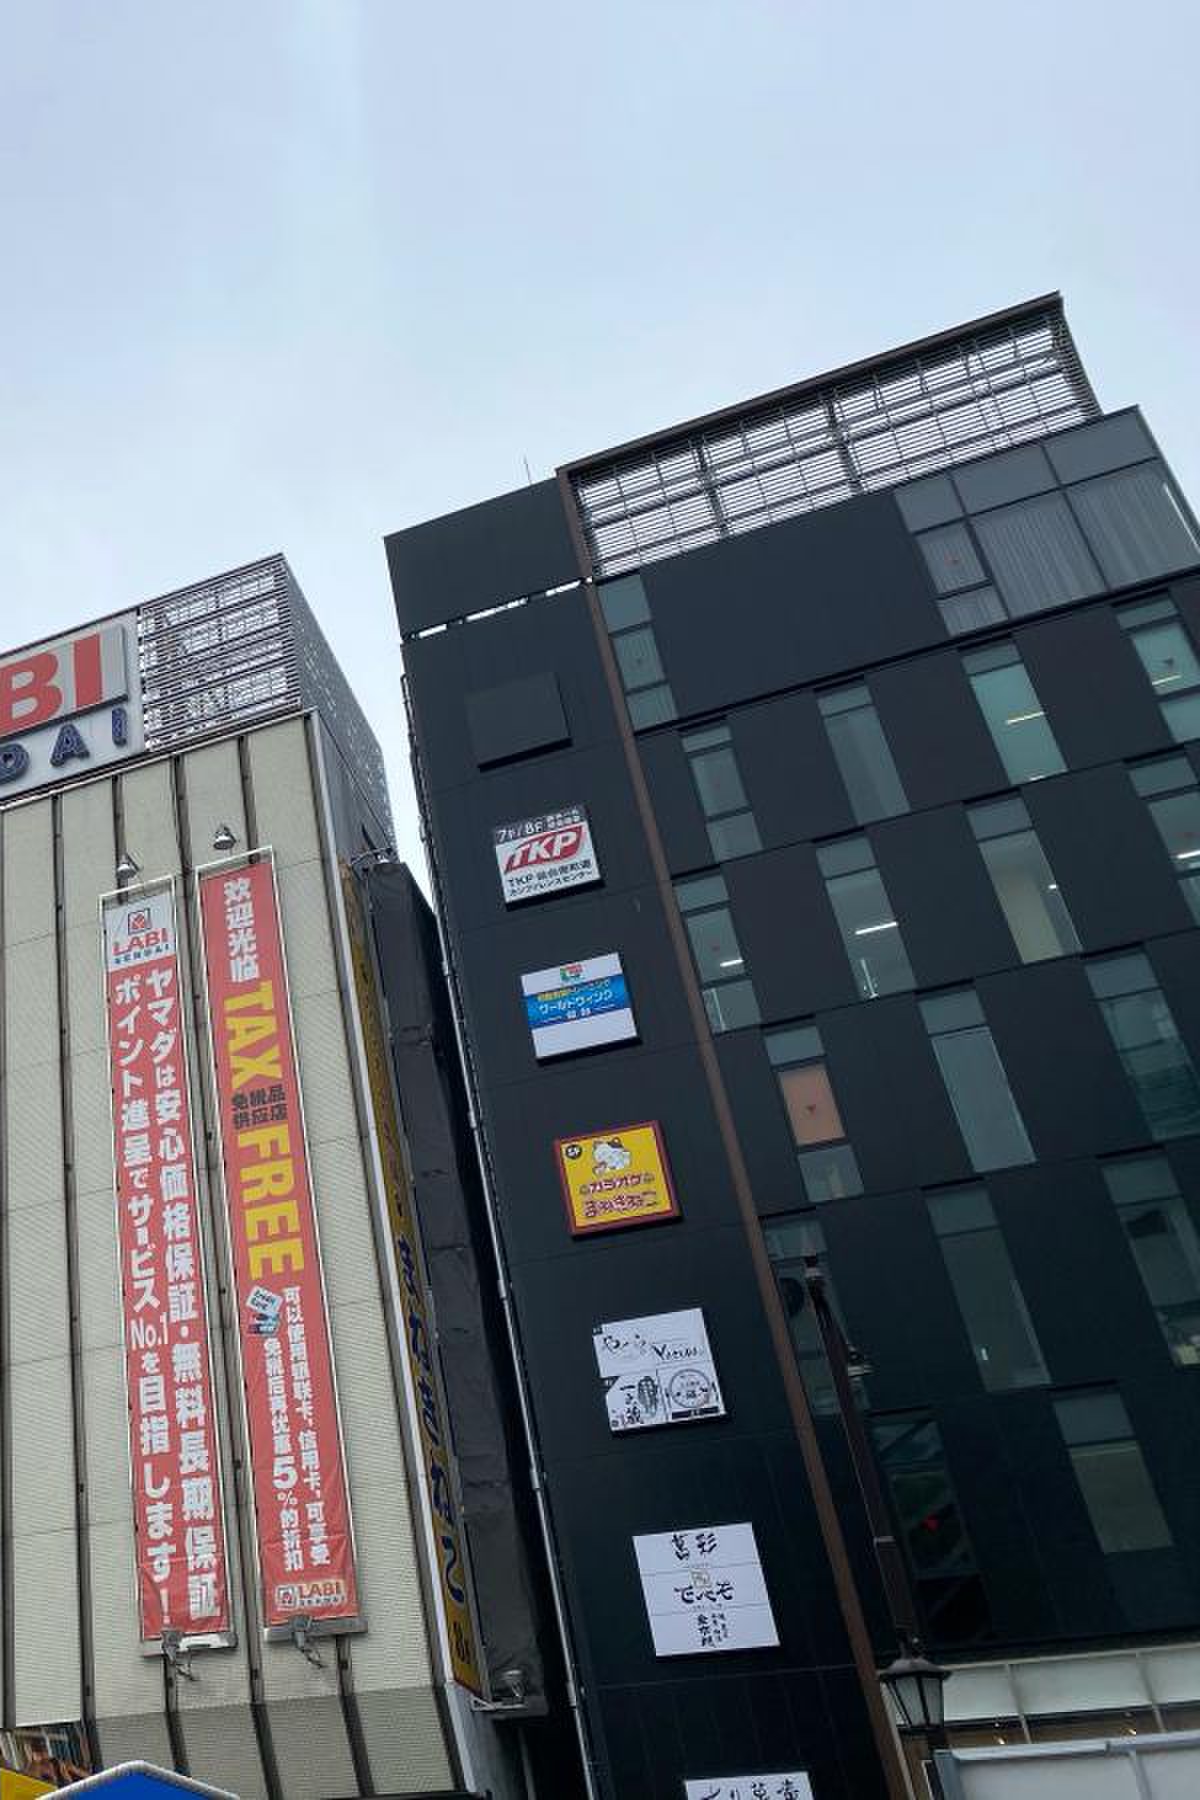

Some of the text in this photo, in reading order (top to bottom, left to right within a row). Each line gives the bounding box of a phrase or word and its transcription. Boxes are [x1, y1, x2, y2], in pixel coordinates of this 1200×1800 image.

[510, 831, 578, 868] TKP
[112, 927, 168, 956] LABI
[224, 980, 283, 1089] TAX
[239, 1124, 304, 1281] FREE
[301, 1581, 341, 1598] LABI
